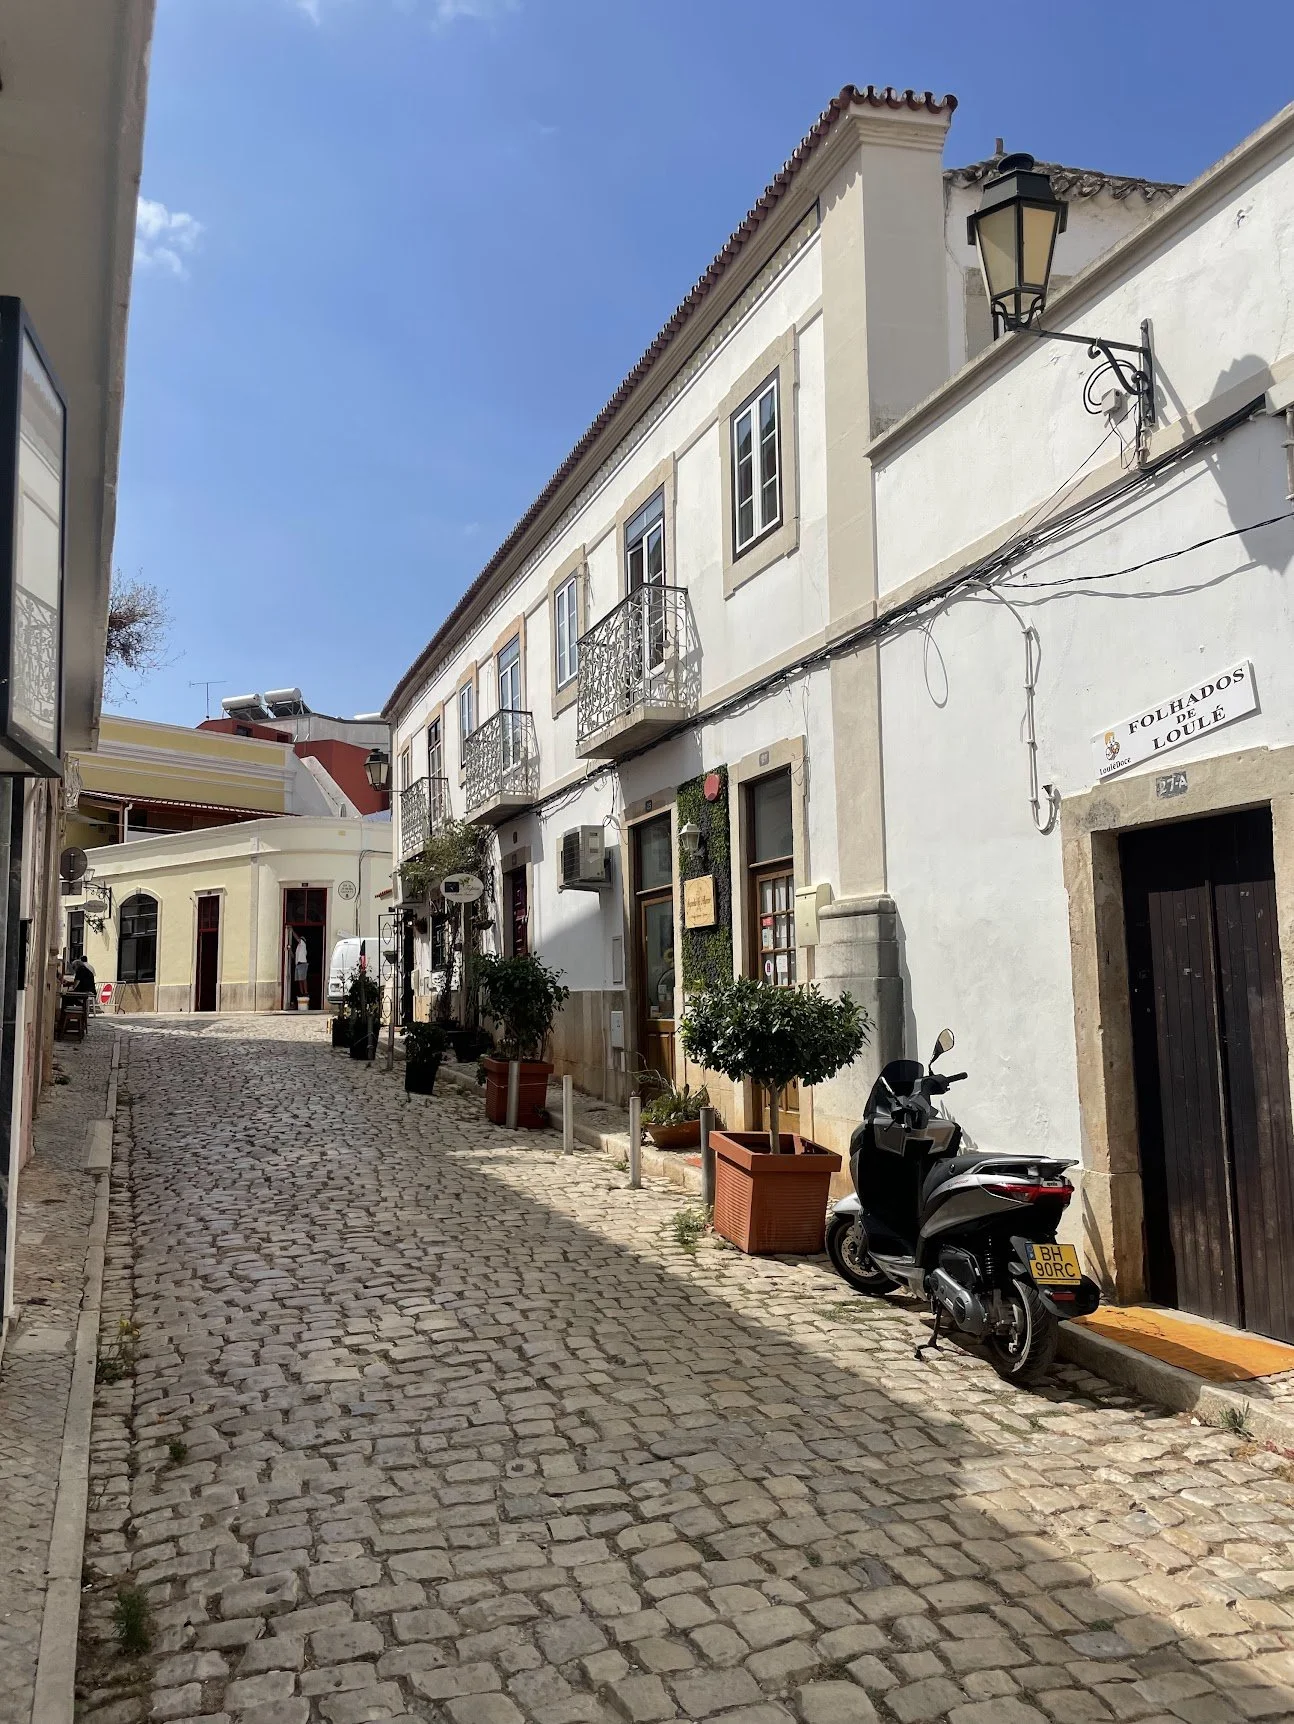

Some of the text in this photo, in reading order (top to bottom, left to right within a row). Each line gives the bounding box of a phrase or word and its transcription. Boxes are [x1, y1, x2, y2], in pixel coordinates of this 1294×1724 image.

[1128, 668, 1245, 735] FOLHADOS
[1176, 708, 1197, 724] DE
[1152, 704, 1226, 751] LOULÉ
[1039, 1246, 1063, 1262] BH
[1035, 1261, 1075, 1277] 90RC
